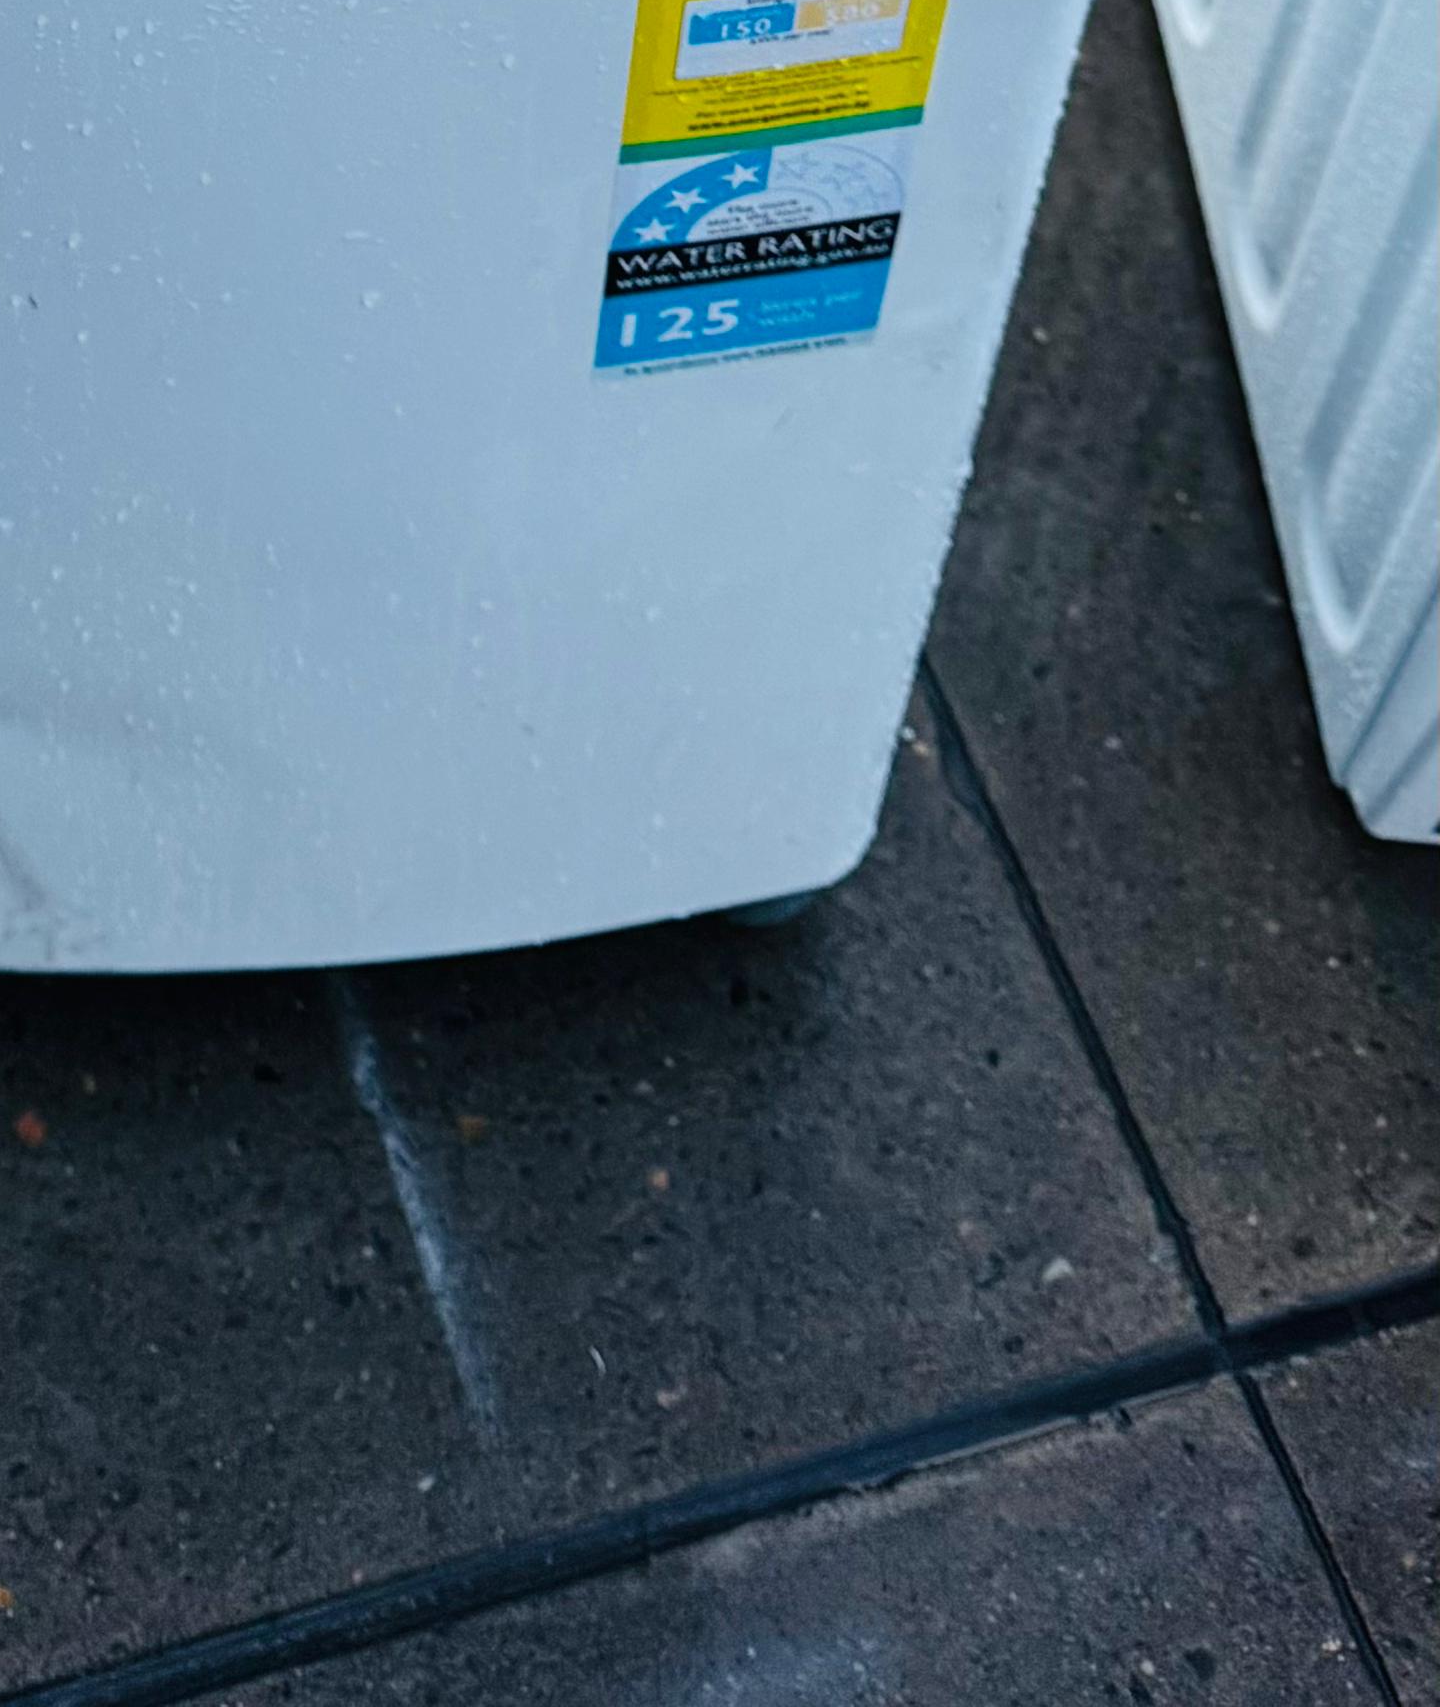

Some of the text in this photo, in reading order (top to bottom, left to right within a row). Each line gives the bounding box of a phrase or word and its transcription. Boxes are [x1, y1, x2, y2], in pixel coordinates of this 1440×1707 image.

[720, 17, 772, 40] 150
[617, 240, 748, 275] WATER
[758, 218, 894, 258] RATING
